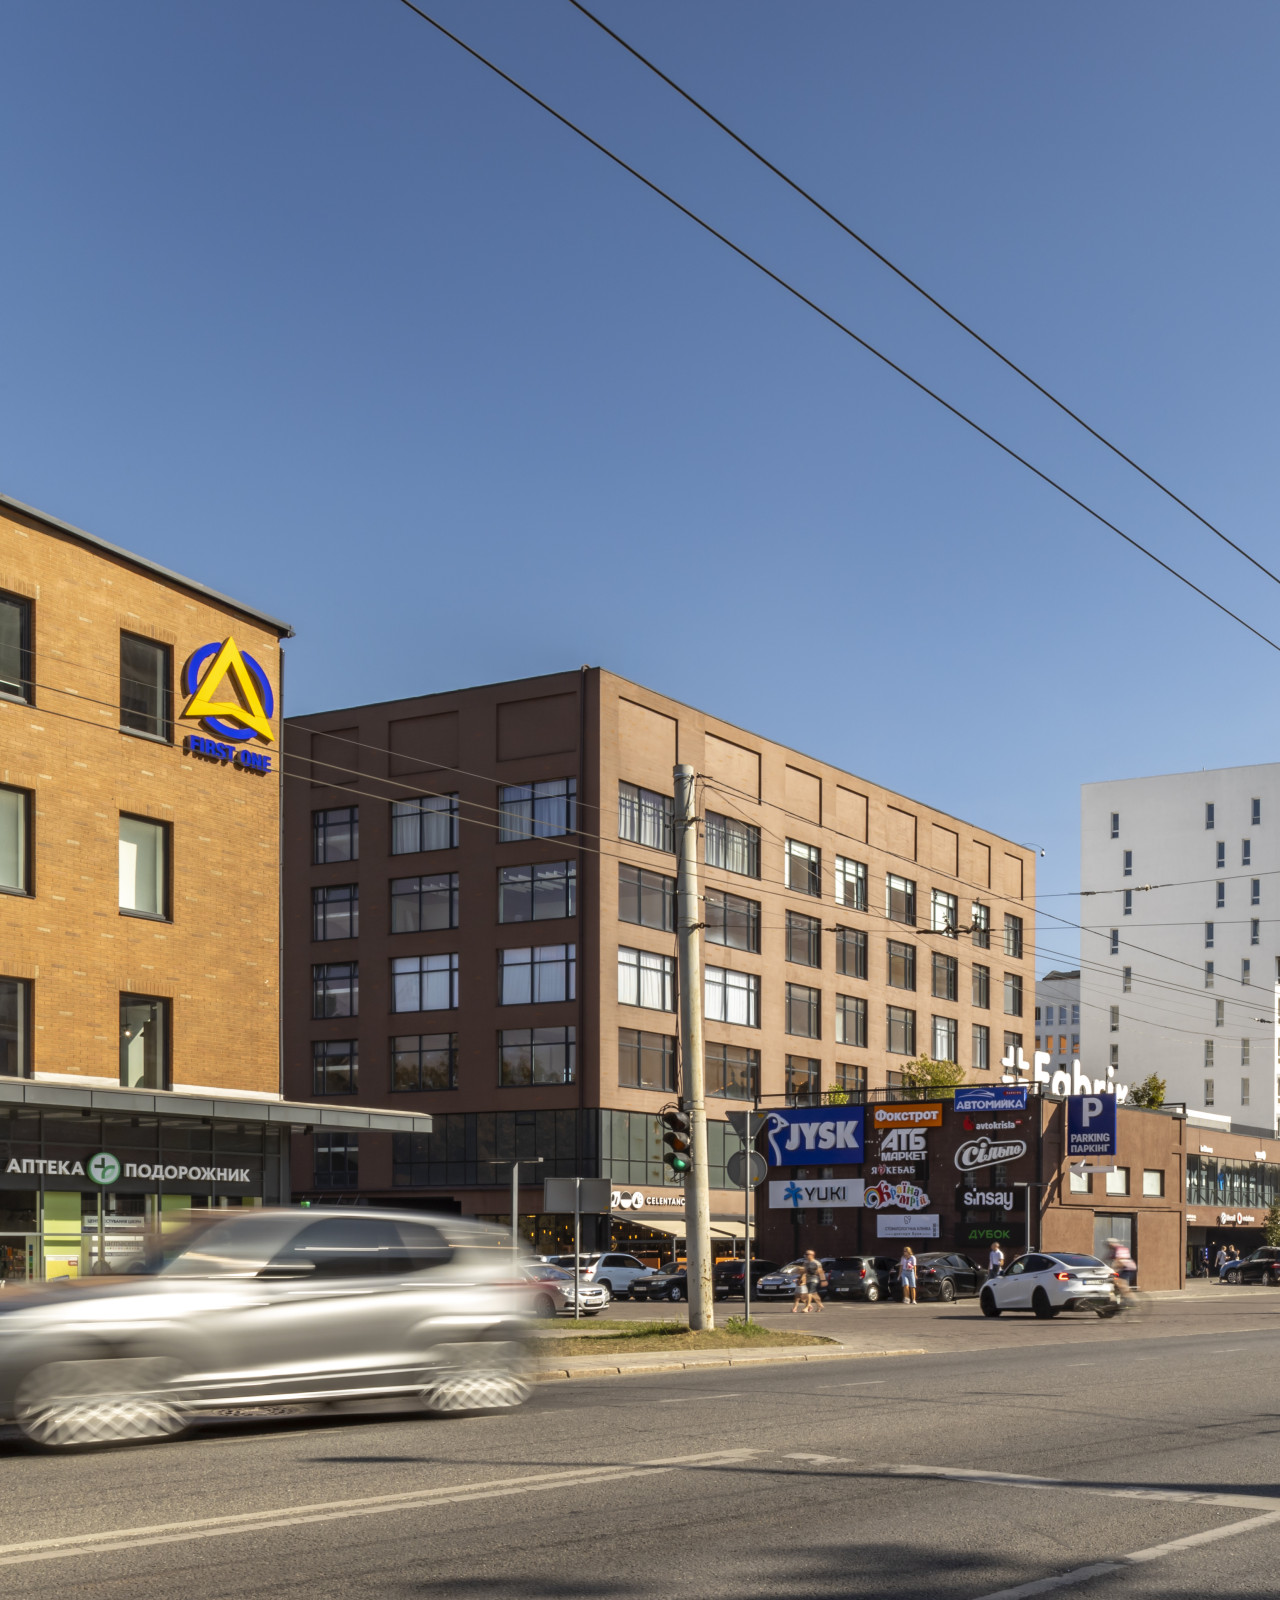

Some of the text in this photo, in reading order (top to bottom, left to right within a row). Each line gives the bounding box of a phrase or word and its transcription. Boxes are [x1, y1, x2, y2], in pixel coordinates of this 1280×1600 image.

[190, 734, 272, 773] FIRST ONE
[956, 1098, 1024, 1110] АВТОМИЙКА
[875, 1109, 939, 1123] Фокстрот
[1082, 1097, 1103, 1127] P
[975, 1120, 1016, 1130] avtokrisla
[785, 1120, 860, 1151] JYSK
[881, 1127, 928, 1151] АТБ
[1070, 1132, 1110, 1143] PARKING
[961, 1142, 1022, 1166] Сільпо
[1070, 1144, 1110, 1153] ПАРКІНГ
[881, 1151, 928, 1161] МАРКЕТ
[6, 1158, 251, 1182] АПТЕКА ПОДОРОЖНИК
[871, 1166, 916, 1174] Я КЕБАБ
[804, 1186, 847, 1201] YUKI
[963, 1187, 1013, 1211] sinsay
[968, 1229, 1010, 1240] ДУБОК
